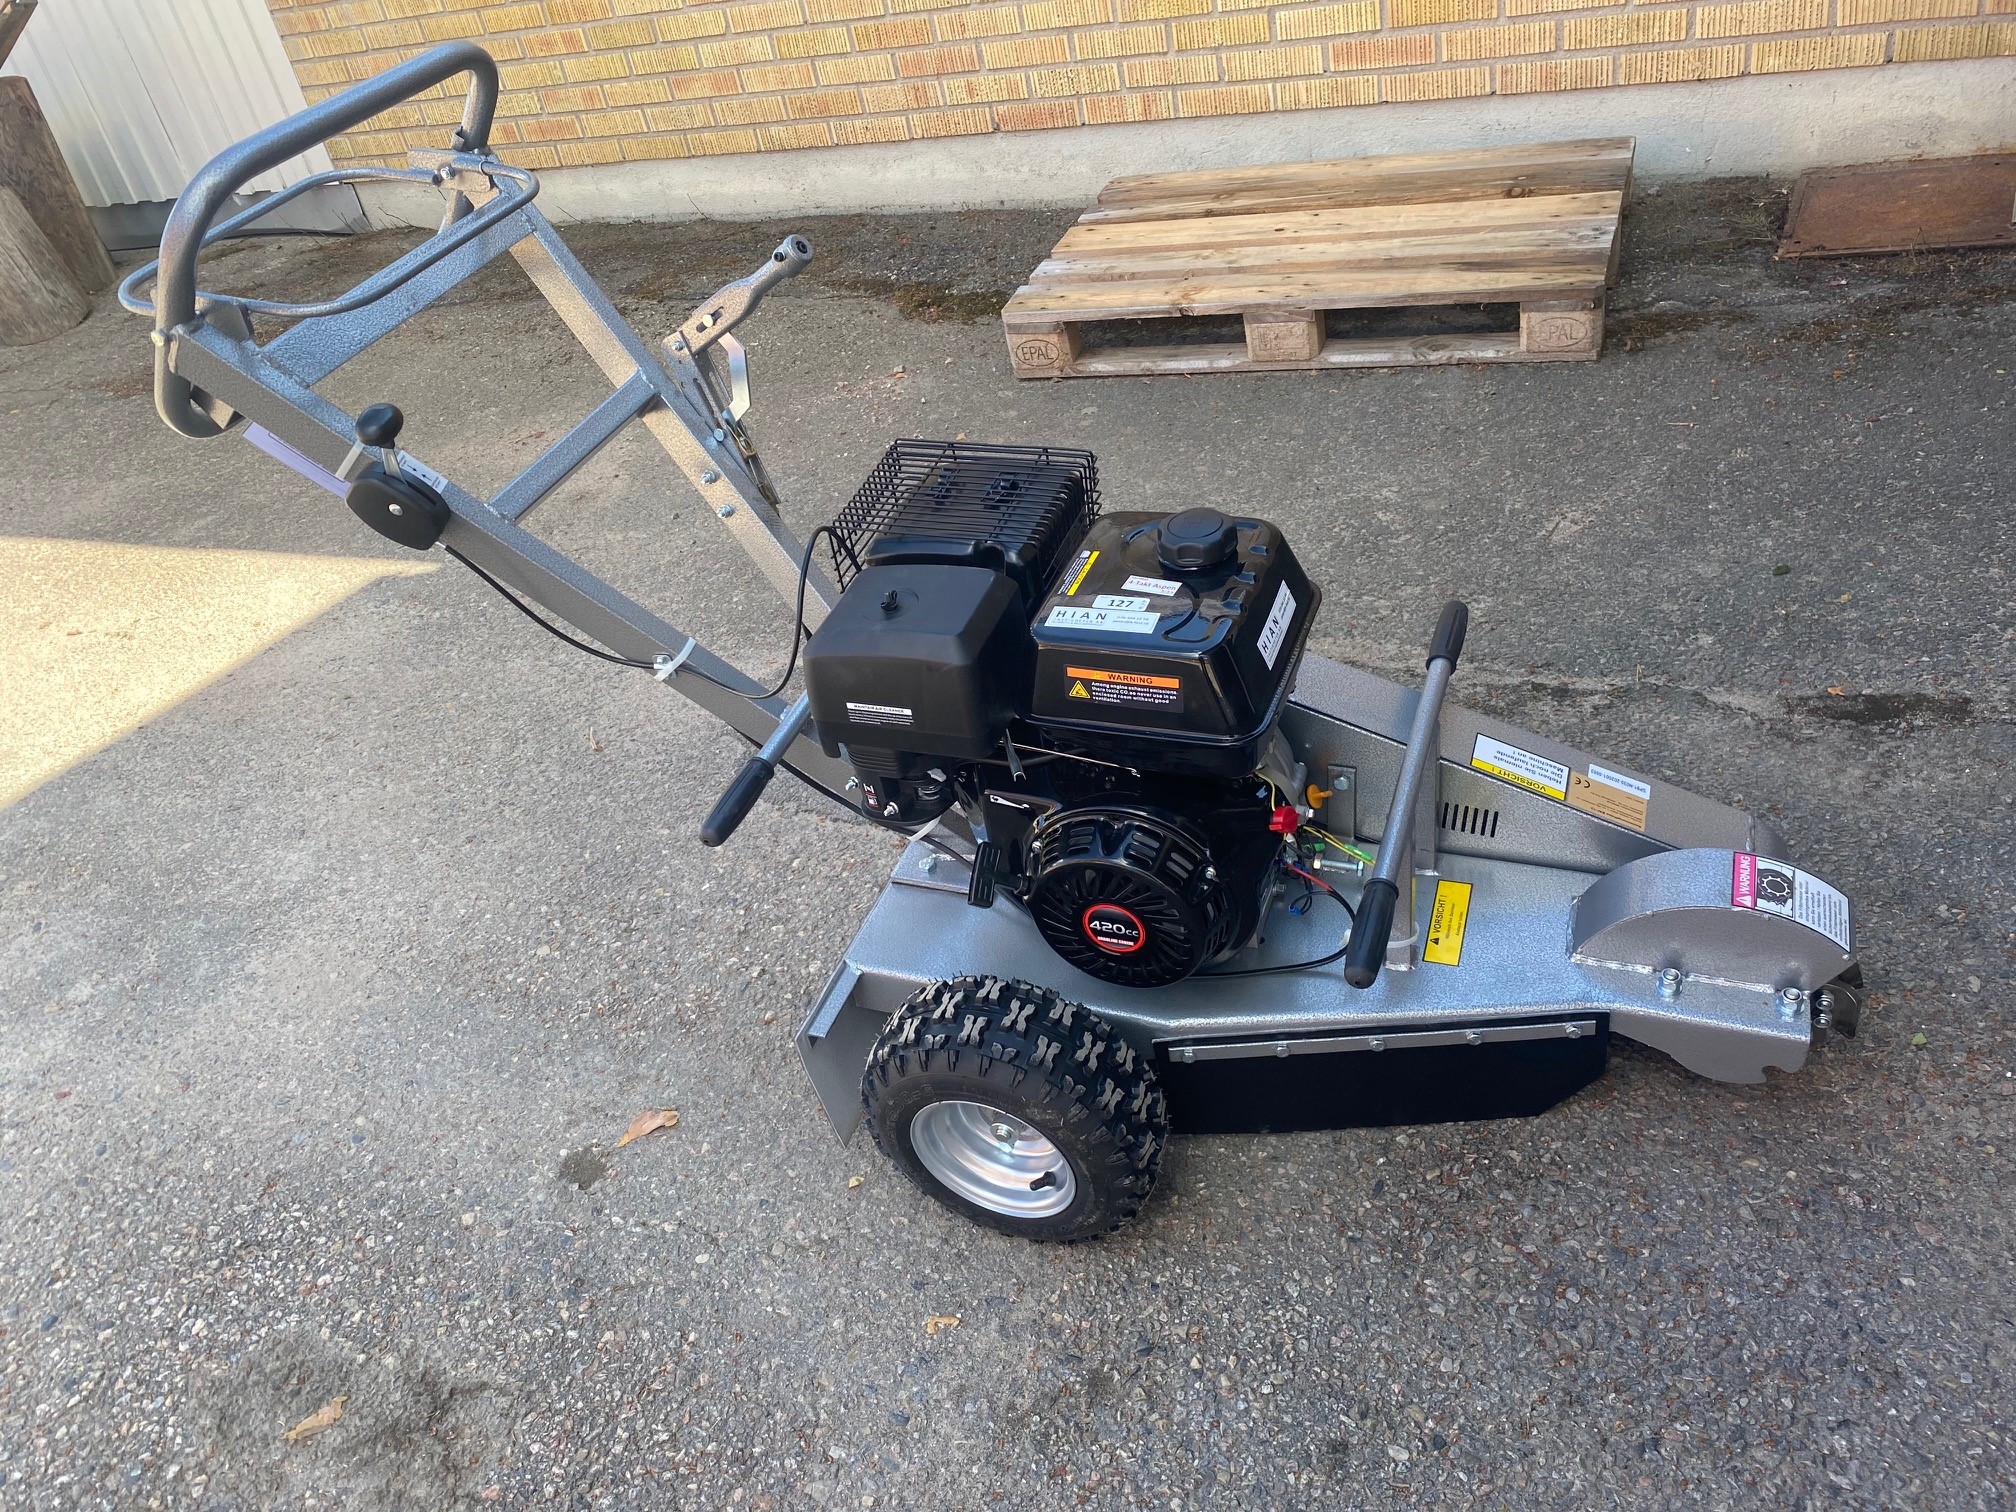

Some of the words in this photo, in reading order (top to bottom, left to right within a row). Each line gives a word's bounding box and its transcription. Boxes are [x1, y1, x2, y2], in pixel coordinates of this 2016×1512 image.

[1021, 346, 1055, 361] EPAL
[1152, 583, 1177, 591] Aspen
[1106, 599, 1135, 608] 127
[1055, 610, 1108, 620] HIAN
[1261, 615, 1280, 654] HIAN
[1091, 681, 1110, 689] Among
[1107, 673, 1153, 685] WARNING
[1092, 691, 1117, 699] enclosed
[1132, 695, 1155, 703] without
[1493, 755, 1523, 771] niemals
[1496, 750, 1527, 764] laufende
[1524, 766, 1536, 775] Sie
[1528, 756, 1564, 773] Maschine
[1529, 763, 1549, 773] noch
[1547, 774, 1562, 785] Heben
[1550, 770, 1563, 778] Die
[1497, 769, 1547, 792] VORSICHT
[1739, 855, 1751, 894] WARNUNG
[1432, 898, 1446, 934] VORSICHT
[1089, 920, 1139, 937] 420cc
